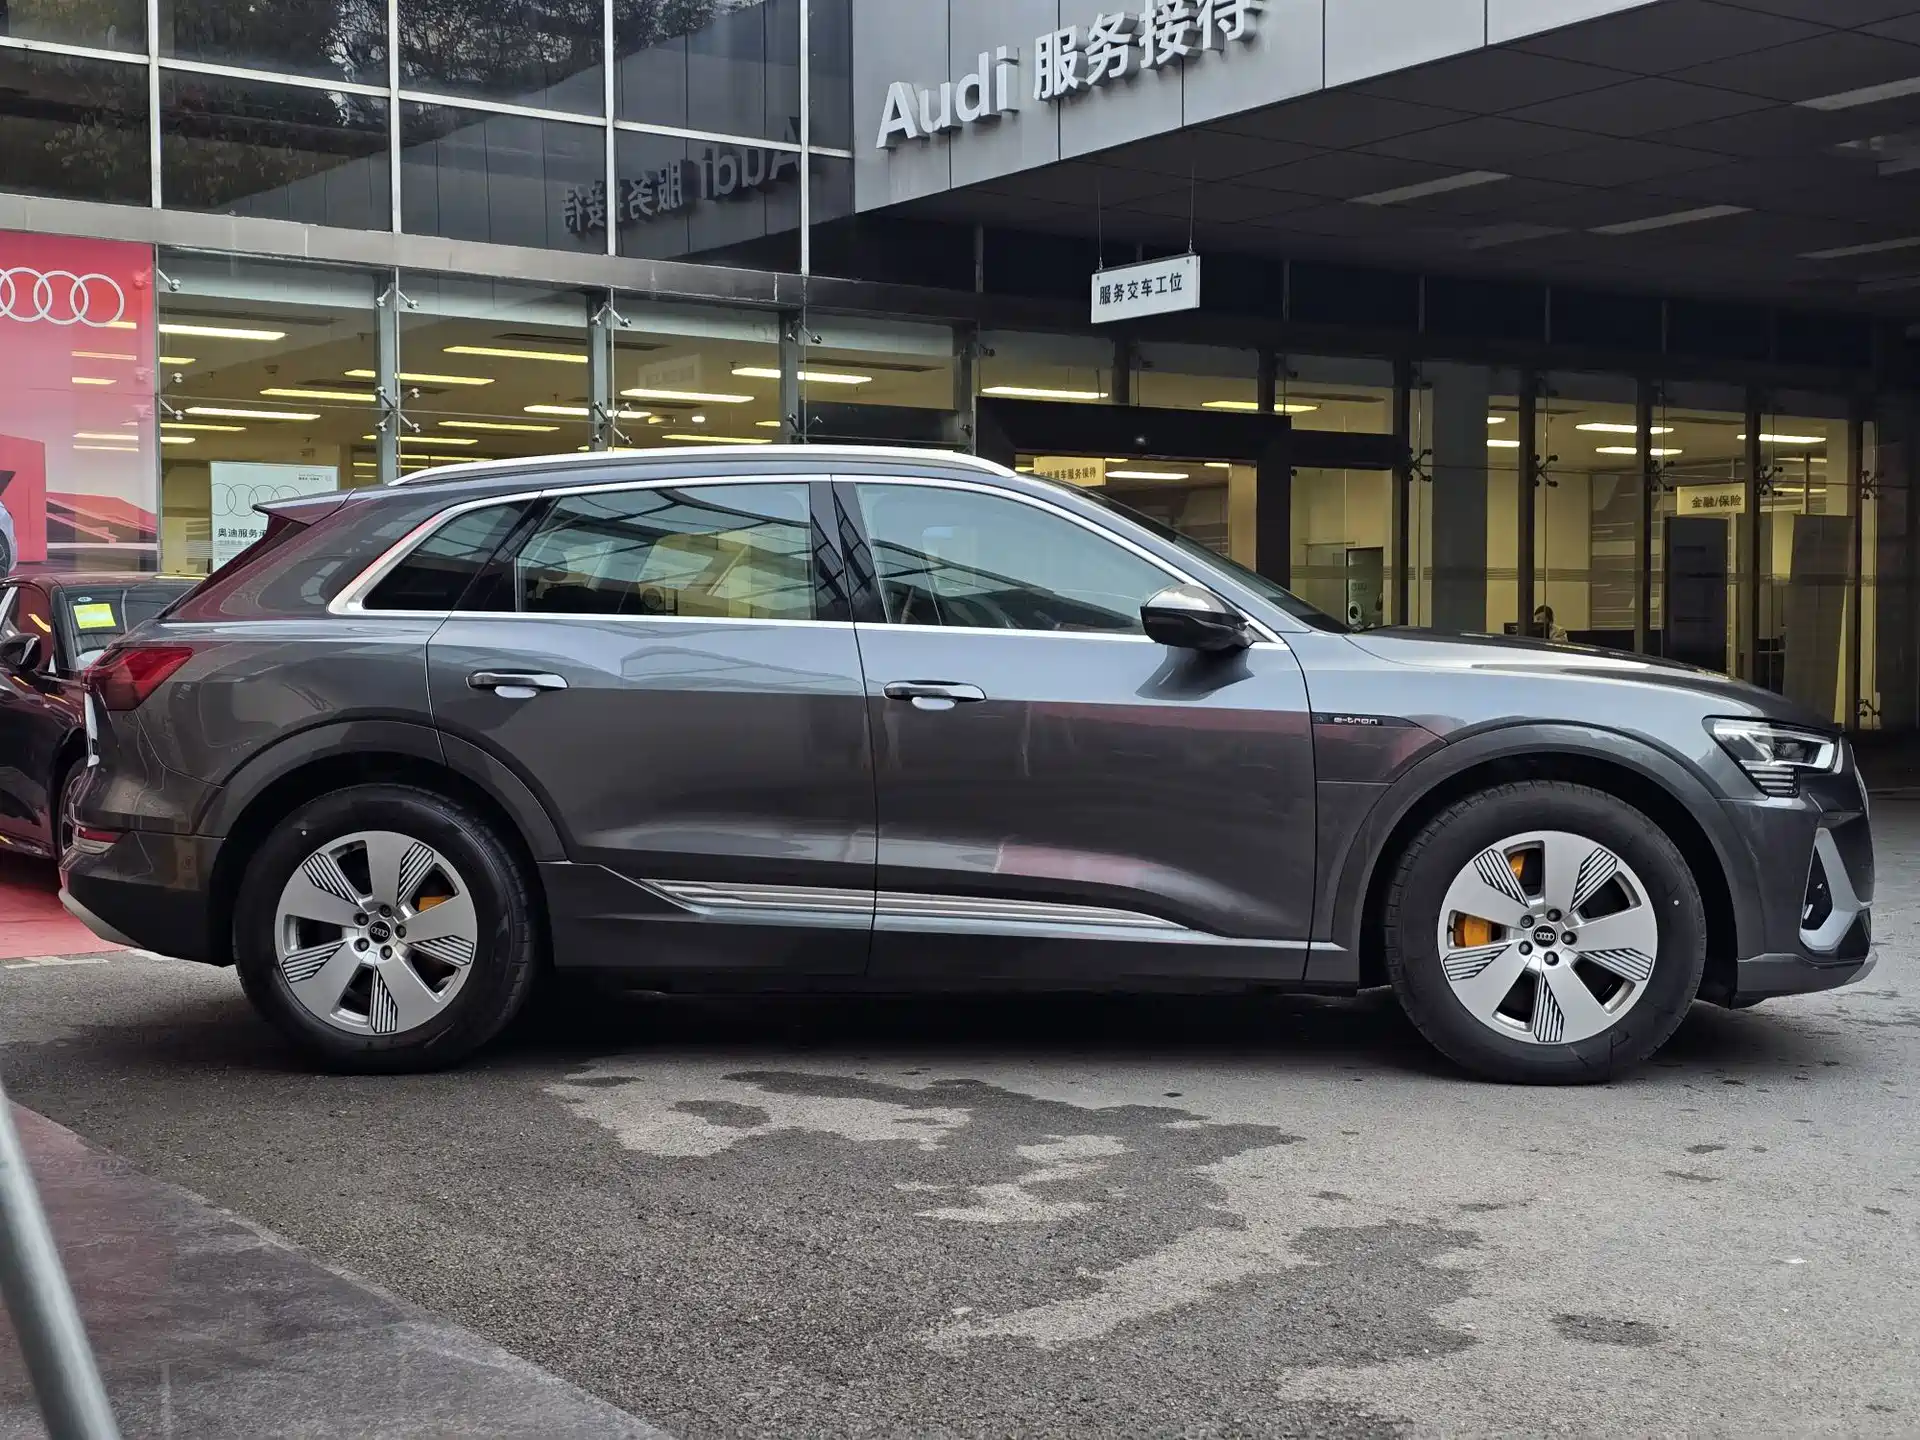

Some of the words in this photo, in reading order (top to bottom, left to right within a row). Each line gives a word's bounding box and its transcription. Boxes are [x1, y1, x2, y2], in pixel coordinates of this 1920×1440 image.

[876, 46, 1012, 149] Audi
[1033, 0, 1249, 100] 服务接待
[1099, 272, 1182, 305] 服务交车工位
[1692, 494, 1742, 508] 金融/保险
[1333, 716, 1378, 725] e-tron
